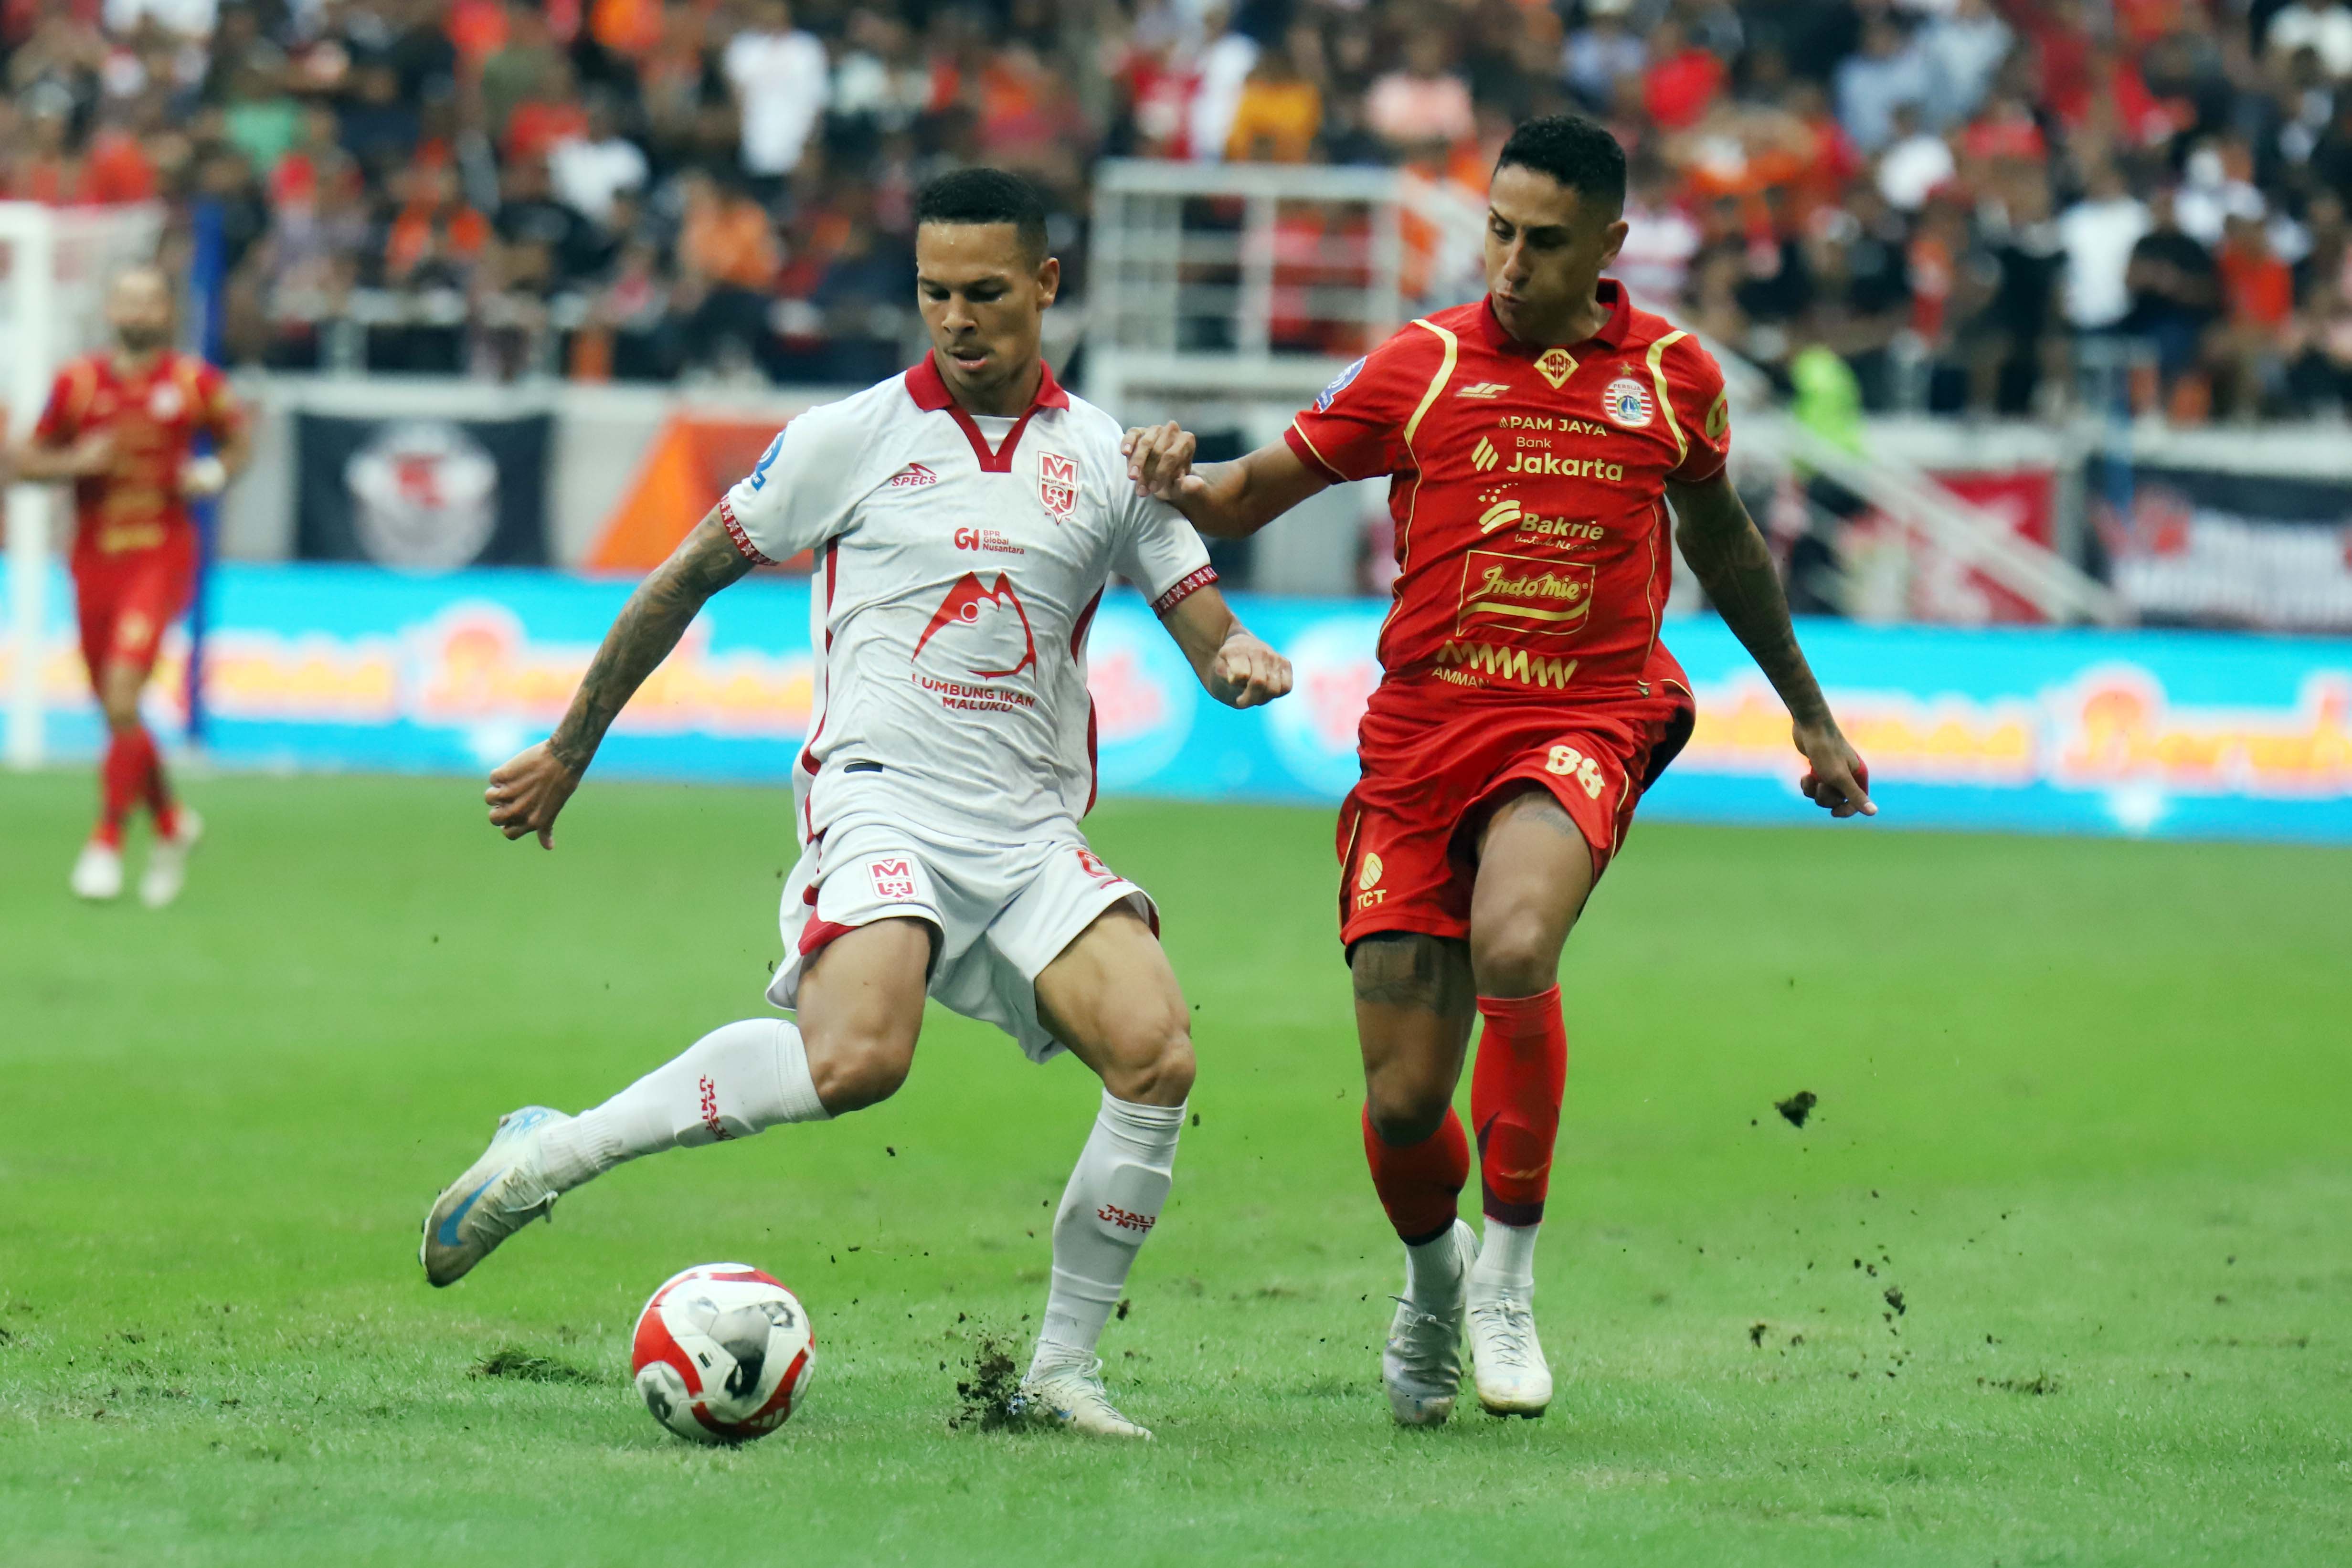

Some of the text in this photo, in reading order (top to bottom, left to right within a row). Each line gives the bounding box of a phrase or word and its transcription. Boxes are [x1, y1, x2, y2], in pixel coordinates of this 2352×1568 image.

[1543, 353, 1571, 379] 1928
[1510, 416, 1607, 437] PAM JAYA
[1516, 436, 1551, 448] Bank
[1506, 452, 1623, 482] Jakarta
[891, 476, 937, 486] SPECS
[1520, 512, 1604, 540] Bakrie
[983, 543, 1025, 554] Nusantara
[984, 537, 1009, 545] Global
[912, 674, 1035, 708] LUMBUNG IKAN
[942, 696, 1013, 712] MALUKU
[1357, 889, 1387, 910] TCT
